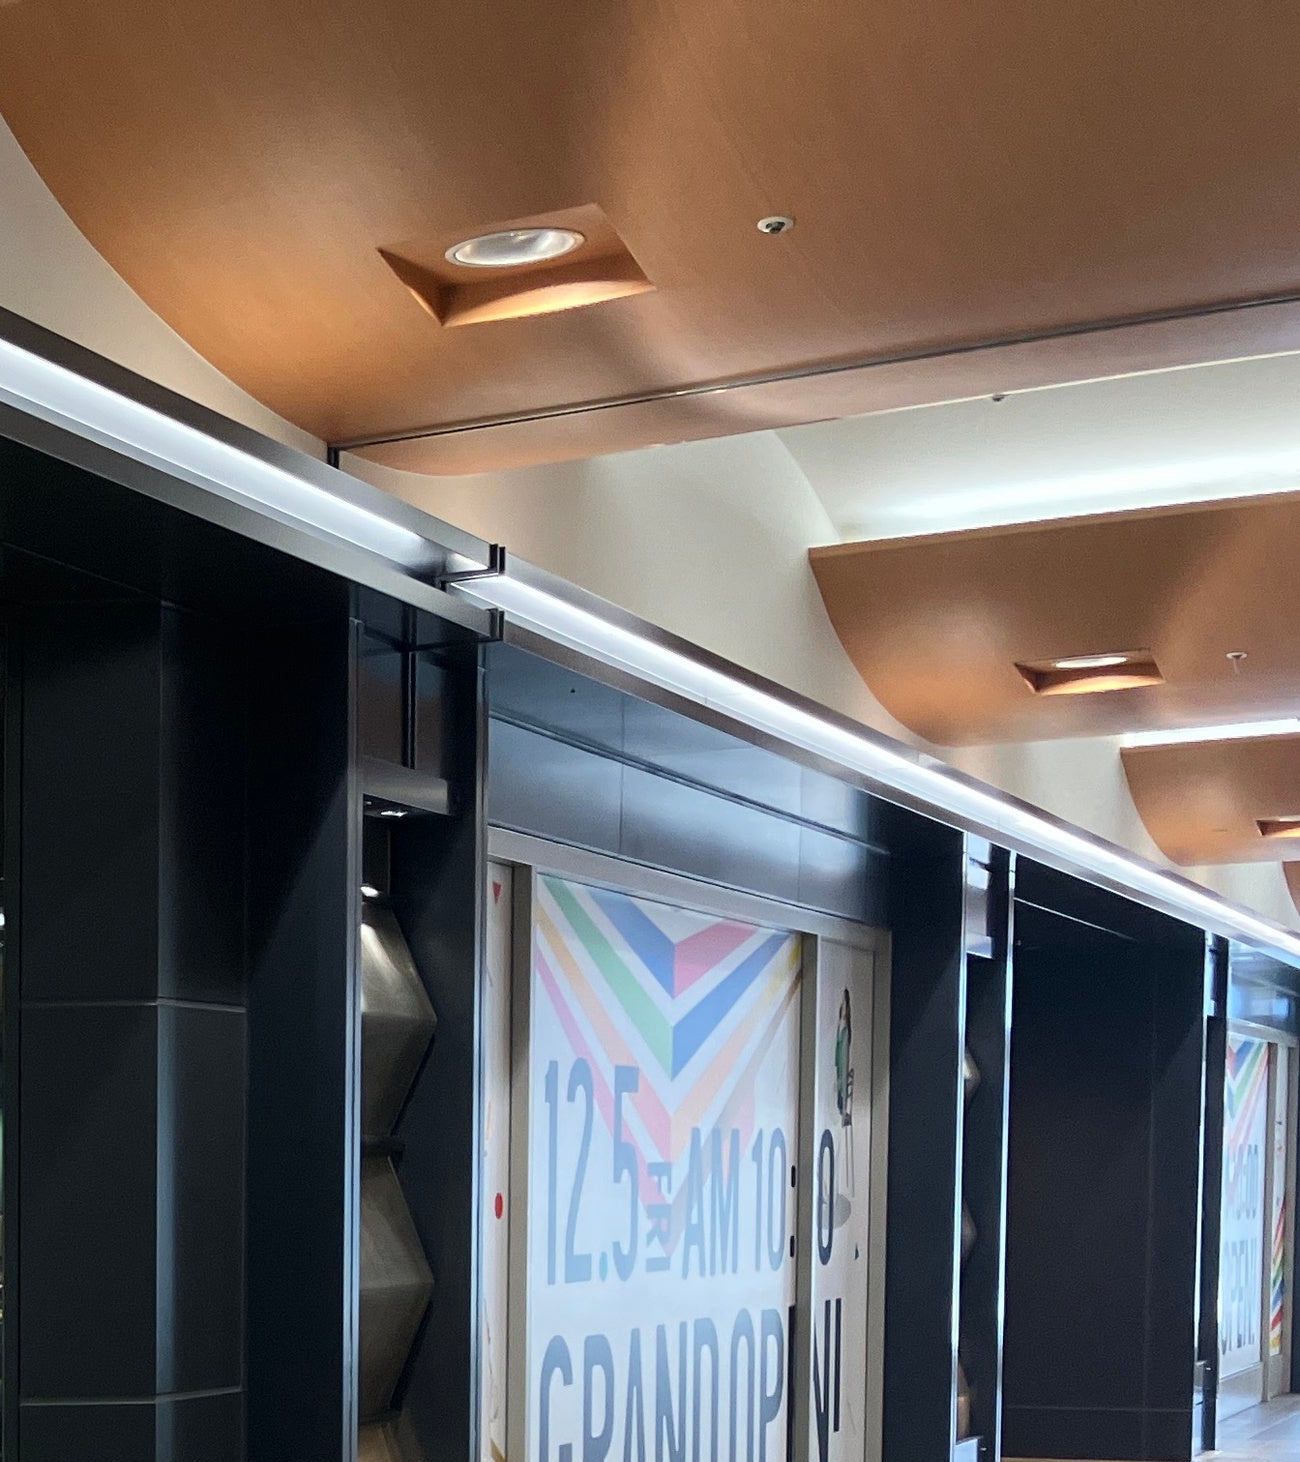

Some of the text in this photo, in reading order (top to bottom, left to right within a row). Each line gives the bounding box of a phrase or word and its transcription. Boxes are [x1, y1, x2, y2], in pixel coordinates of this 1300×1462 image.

[545, 1057, 835, 1285] 12.5 FRI AM 10:0
